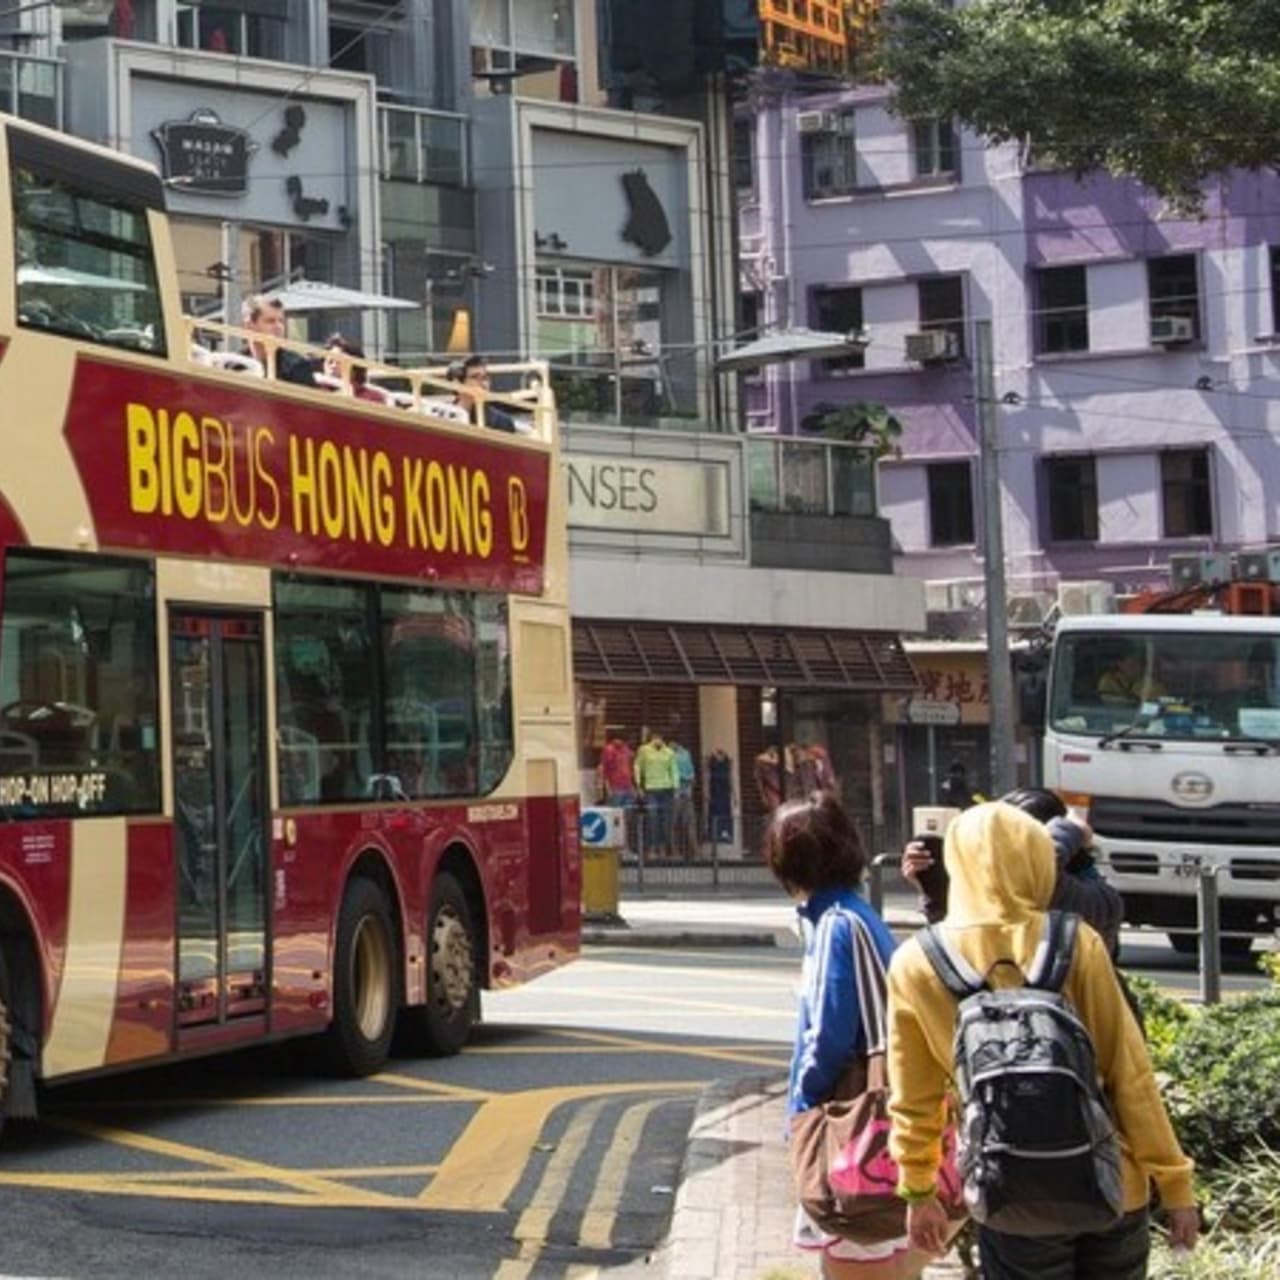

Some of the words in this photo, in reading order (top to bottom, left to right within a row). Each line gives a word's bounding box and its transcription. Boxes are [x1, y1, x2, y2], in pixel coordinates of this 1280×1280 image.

[289, 434, 396, 547] HONG
[403, 456, 493, 559] KONG
[566, 463, 658, 513] NSES
[51, 773, 106, 803] HOP-OFF
